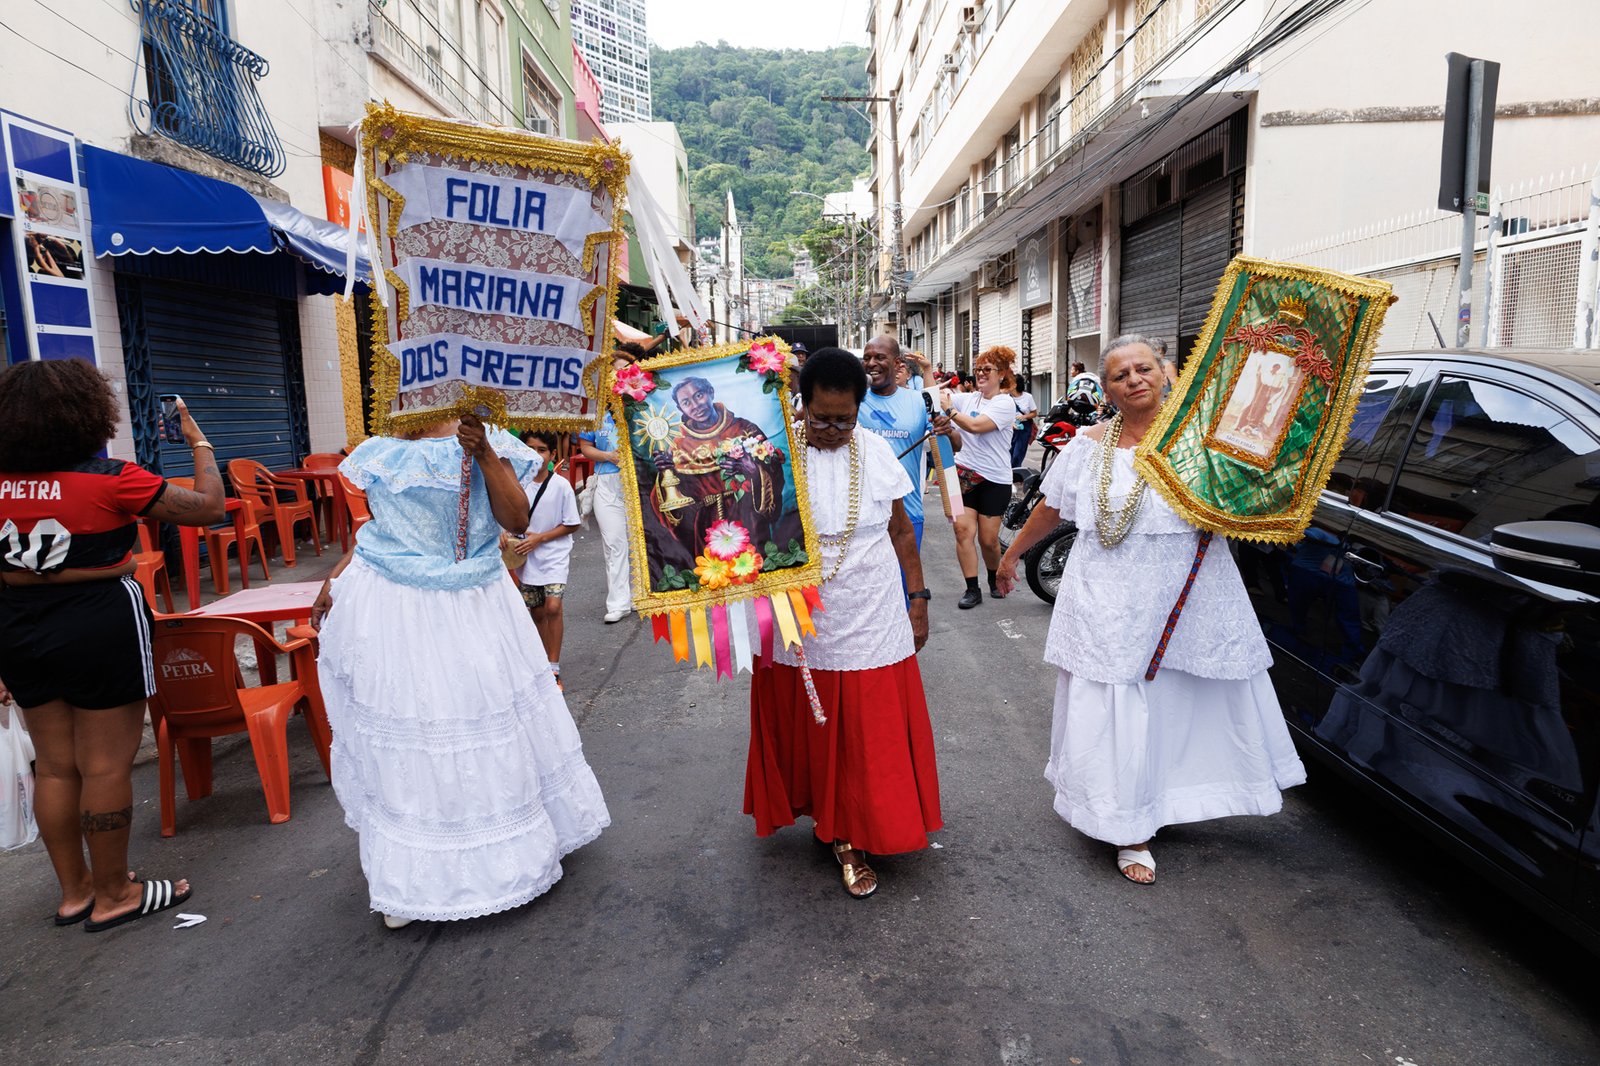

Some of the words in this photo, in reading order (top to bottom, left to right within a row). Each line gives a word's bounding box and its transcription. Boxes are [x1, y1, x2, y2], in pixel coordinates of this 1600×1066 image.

[446, 177, 547, 230] FOLIA
[419, 265, 564, 319] MARIANA
[402, 340, 449, 386] DOS
[461, 345, 583, 390] PRETOS
[0, 480, 62, 500] PIETRA
[161, 662, 214, 678] PETRA
